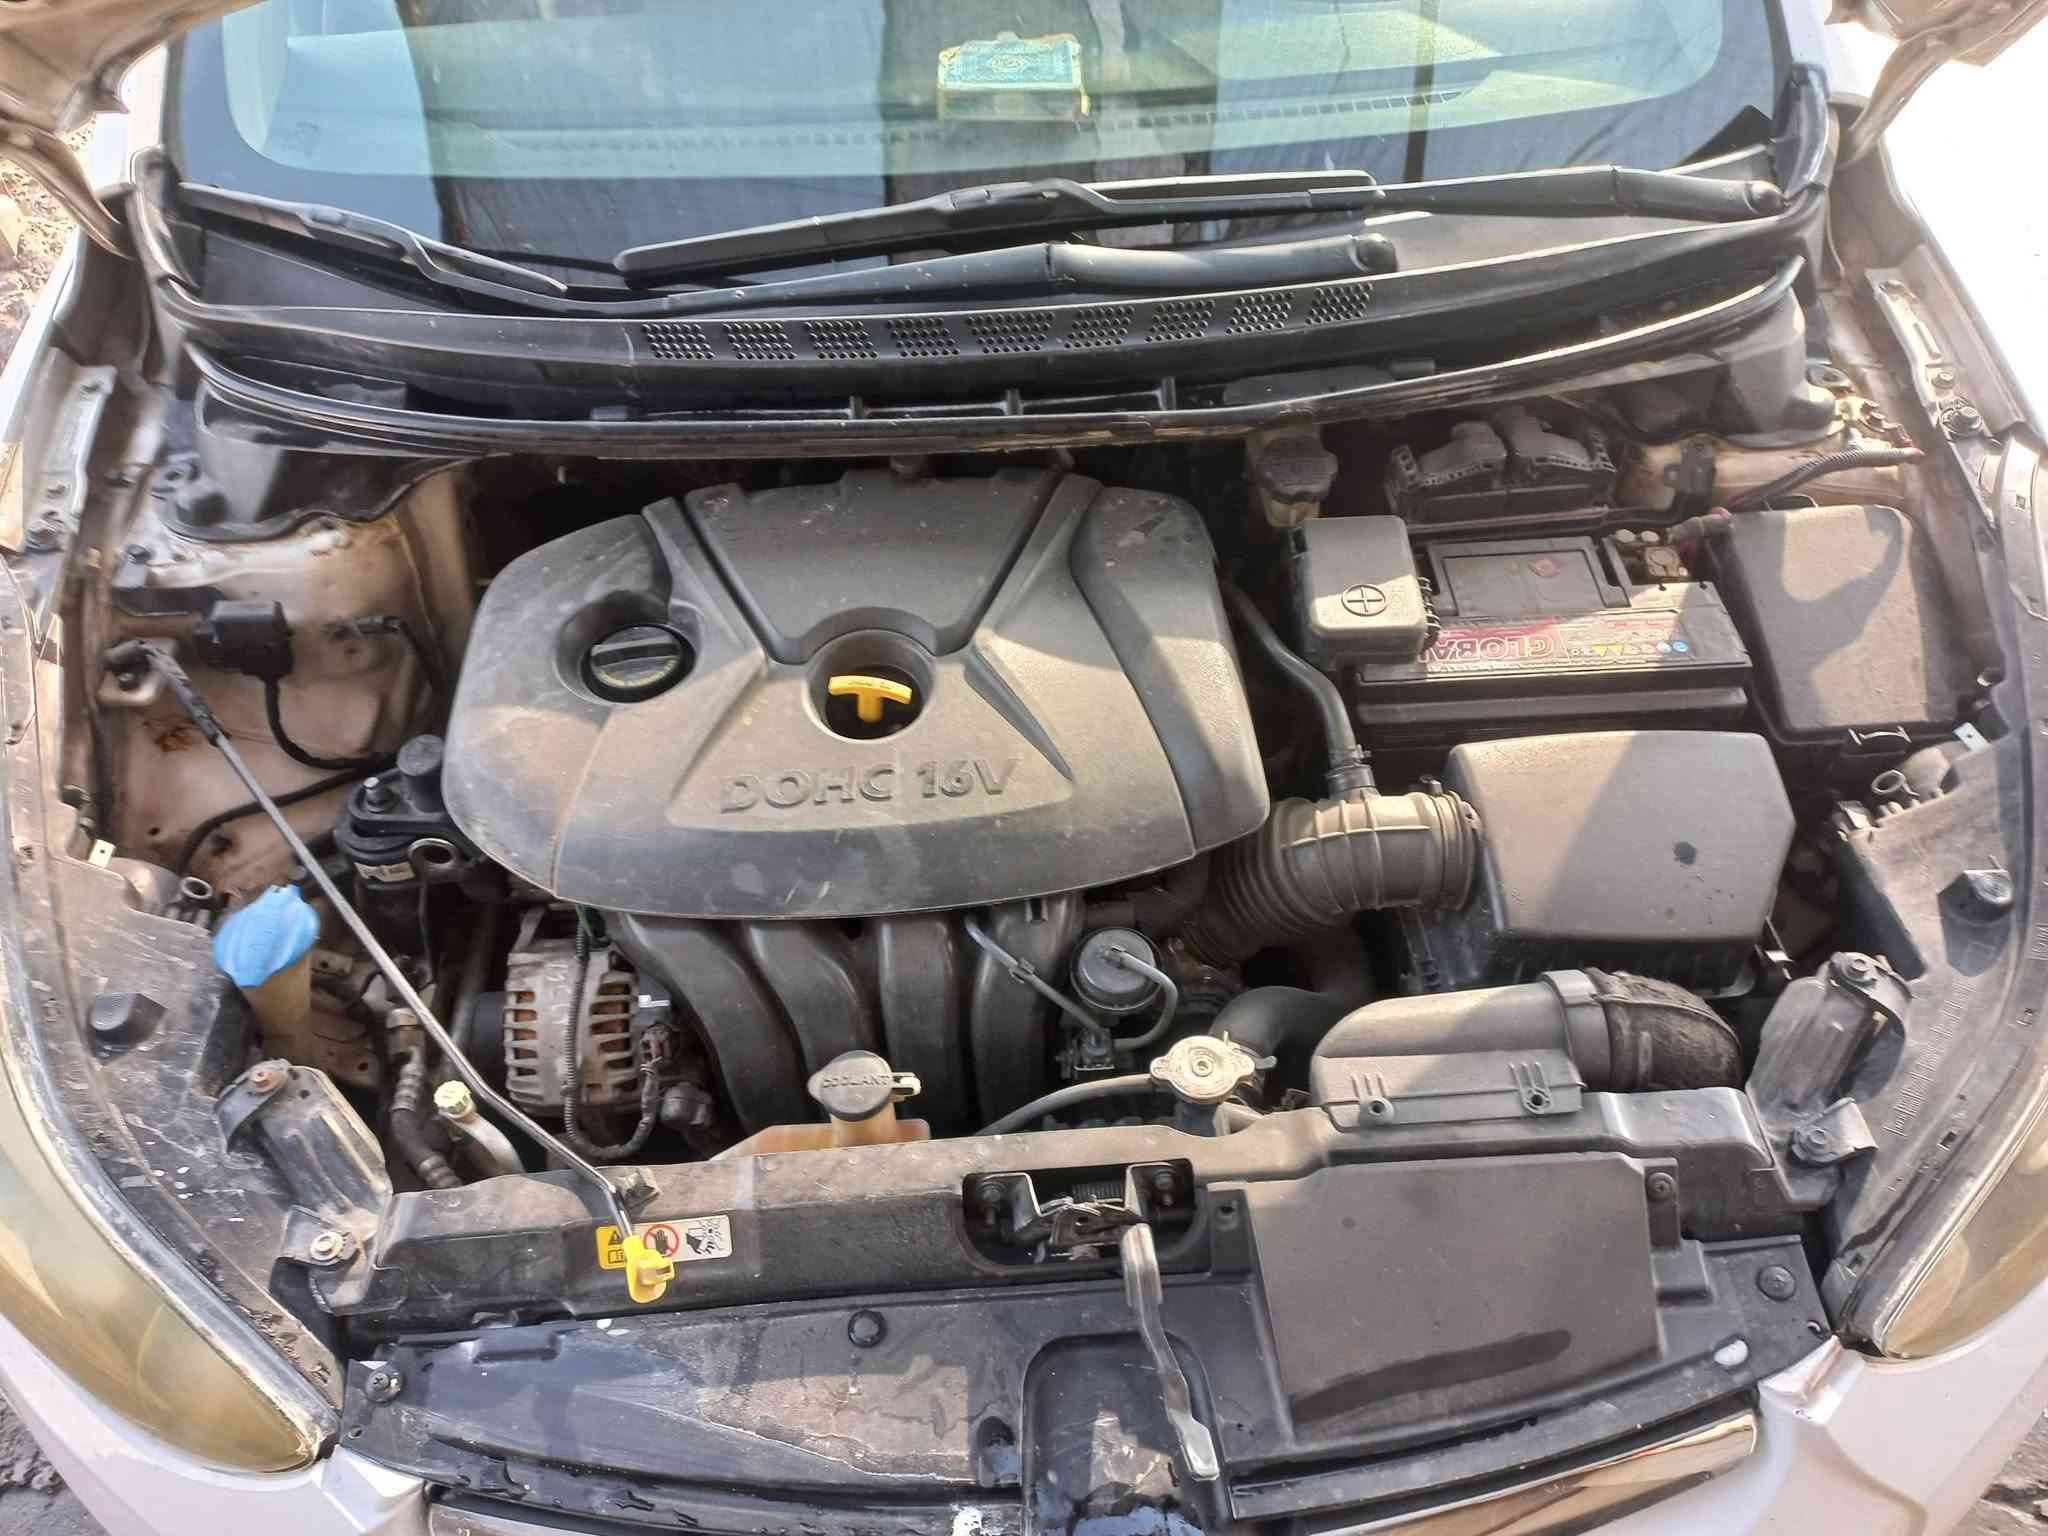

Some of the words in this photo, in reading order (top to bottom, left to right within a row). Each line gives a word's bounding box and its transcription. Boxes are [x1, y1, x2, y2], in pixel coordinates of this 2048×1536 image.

[720, 765, 896, 813] DOHC
[917, 758, 1017, 798] 16V
[823, 1073, 890, 1088] COOLANT
